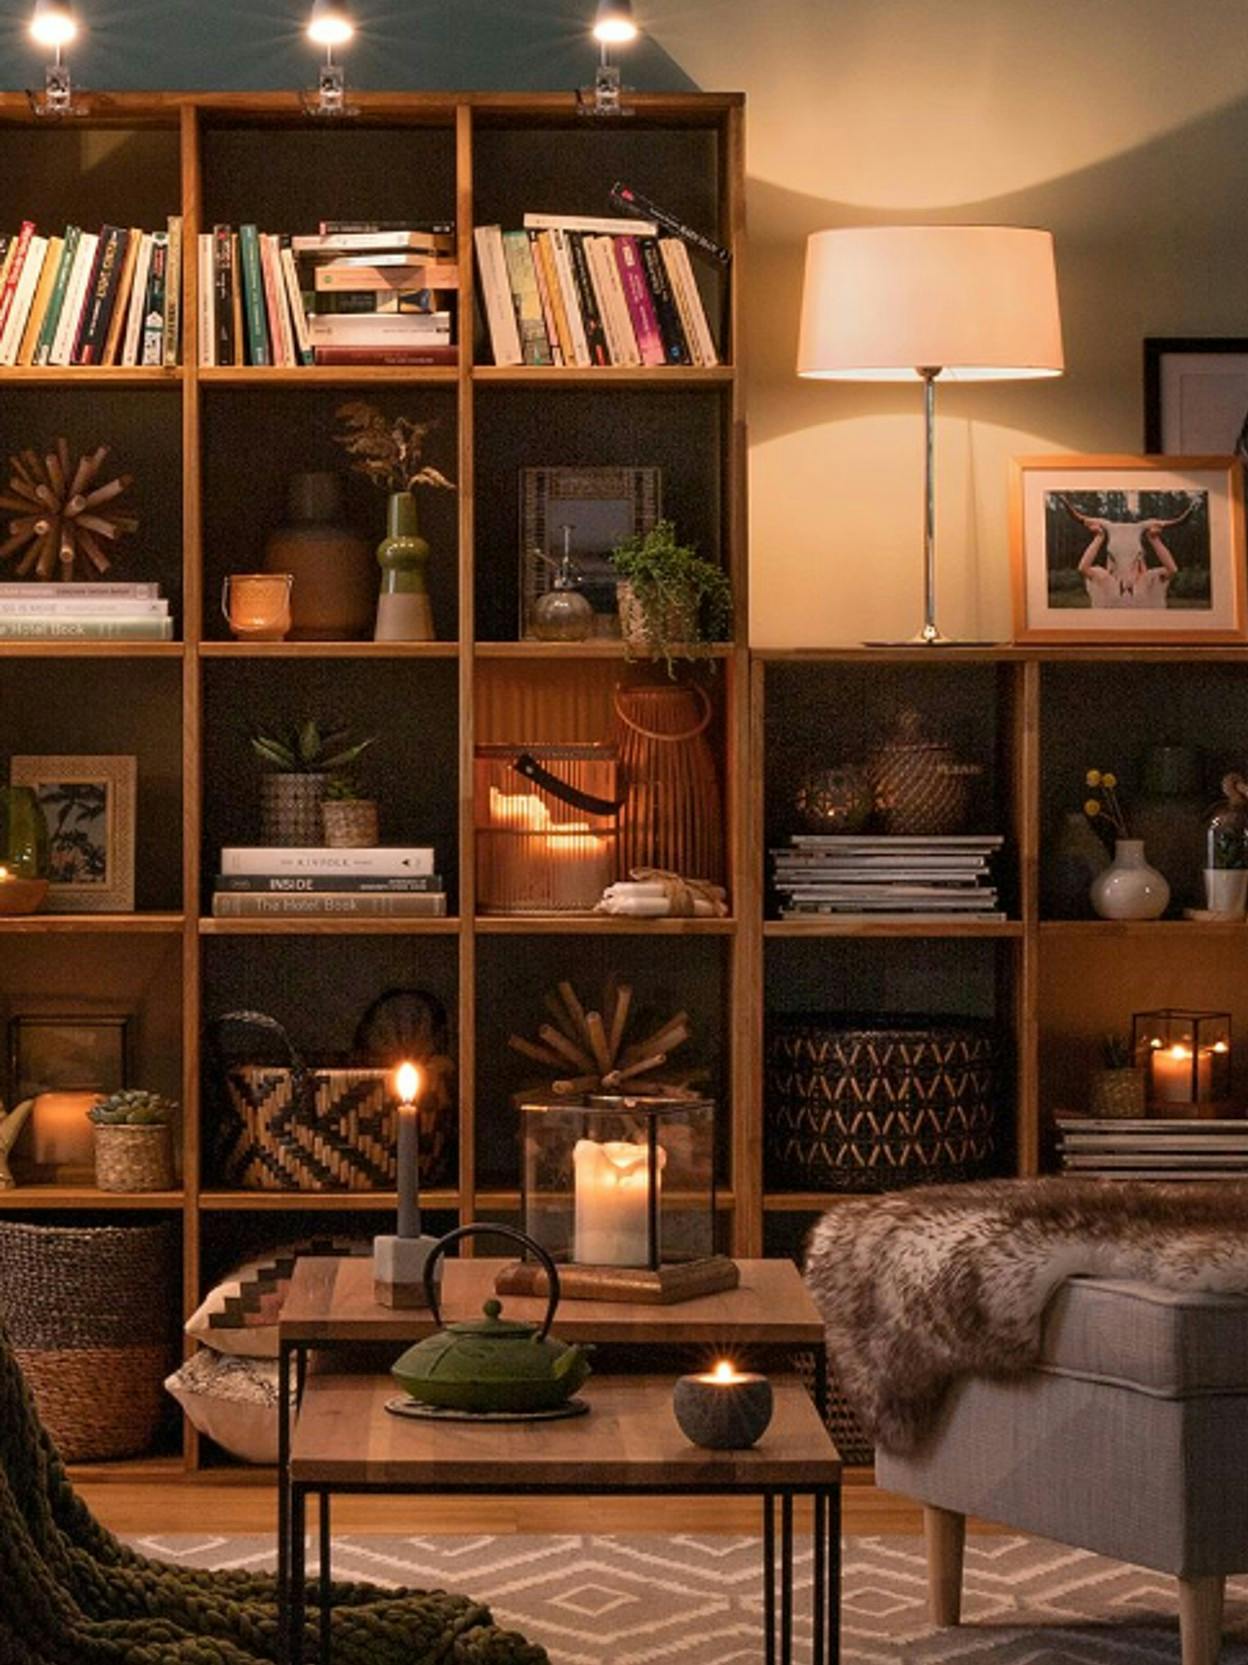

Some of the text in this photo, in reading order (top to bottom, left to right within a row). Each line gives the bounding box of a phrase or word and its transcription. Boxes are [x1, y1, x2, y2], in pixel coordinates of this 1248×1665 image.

[269, 878, 313, 891] INSIDE
[256, 897, 280, 911] The
[283, 896, 318, 911] Hotel
[324, 896, 359, 911] Book
